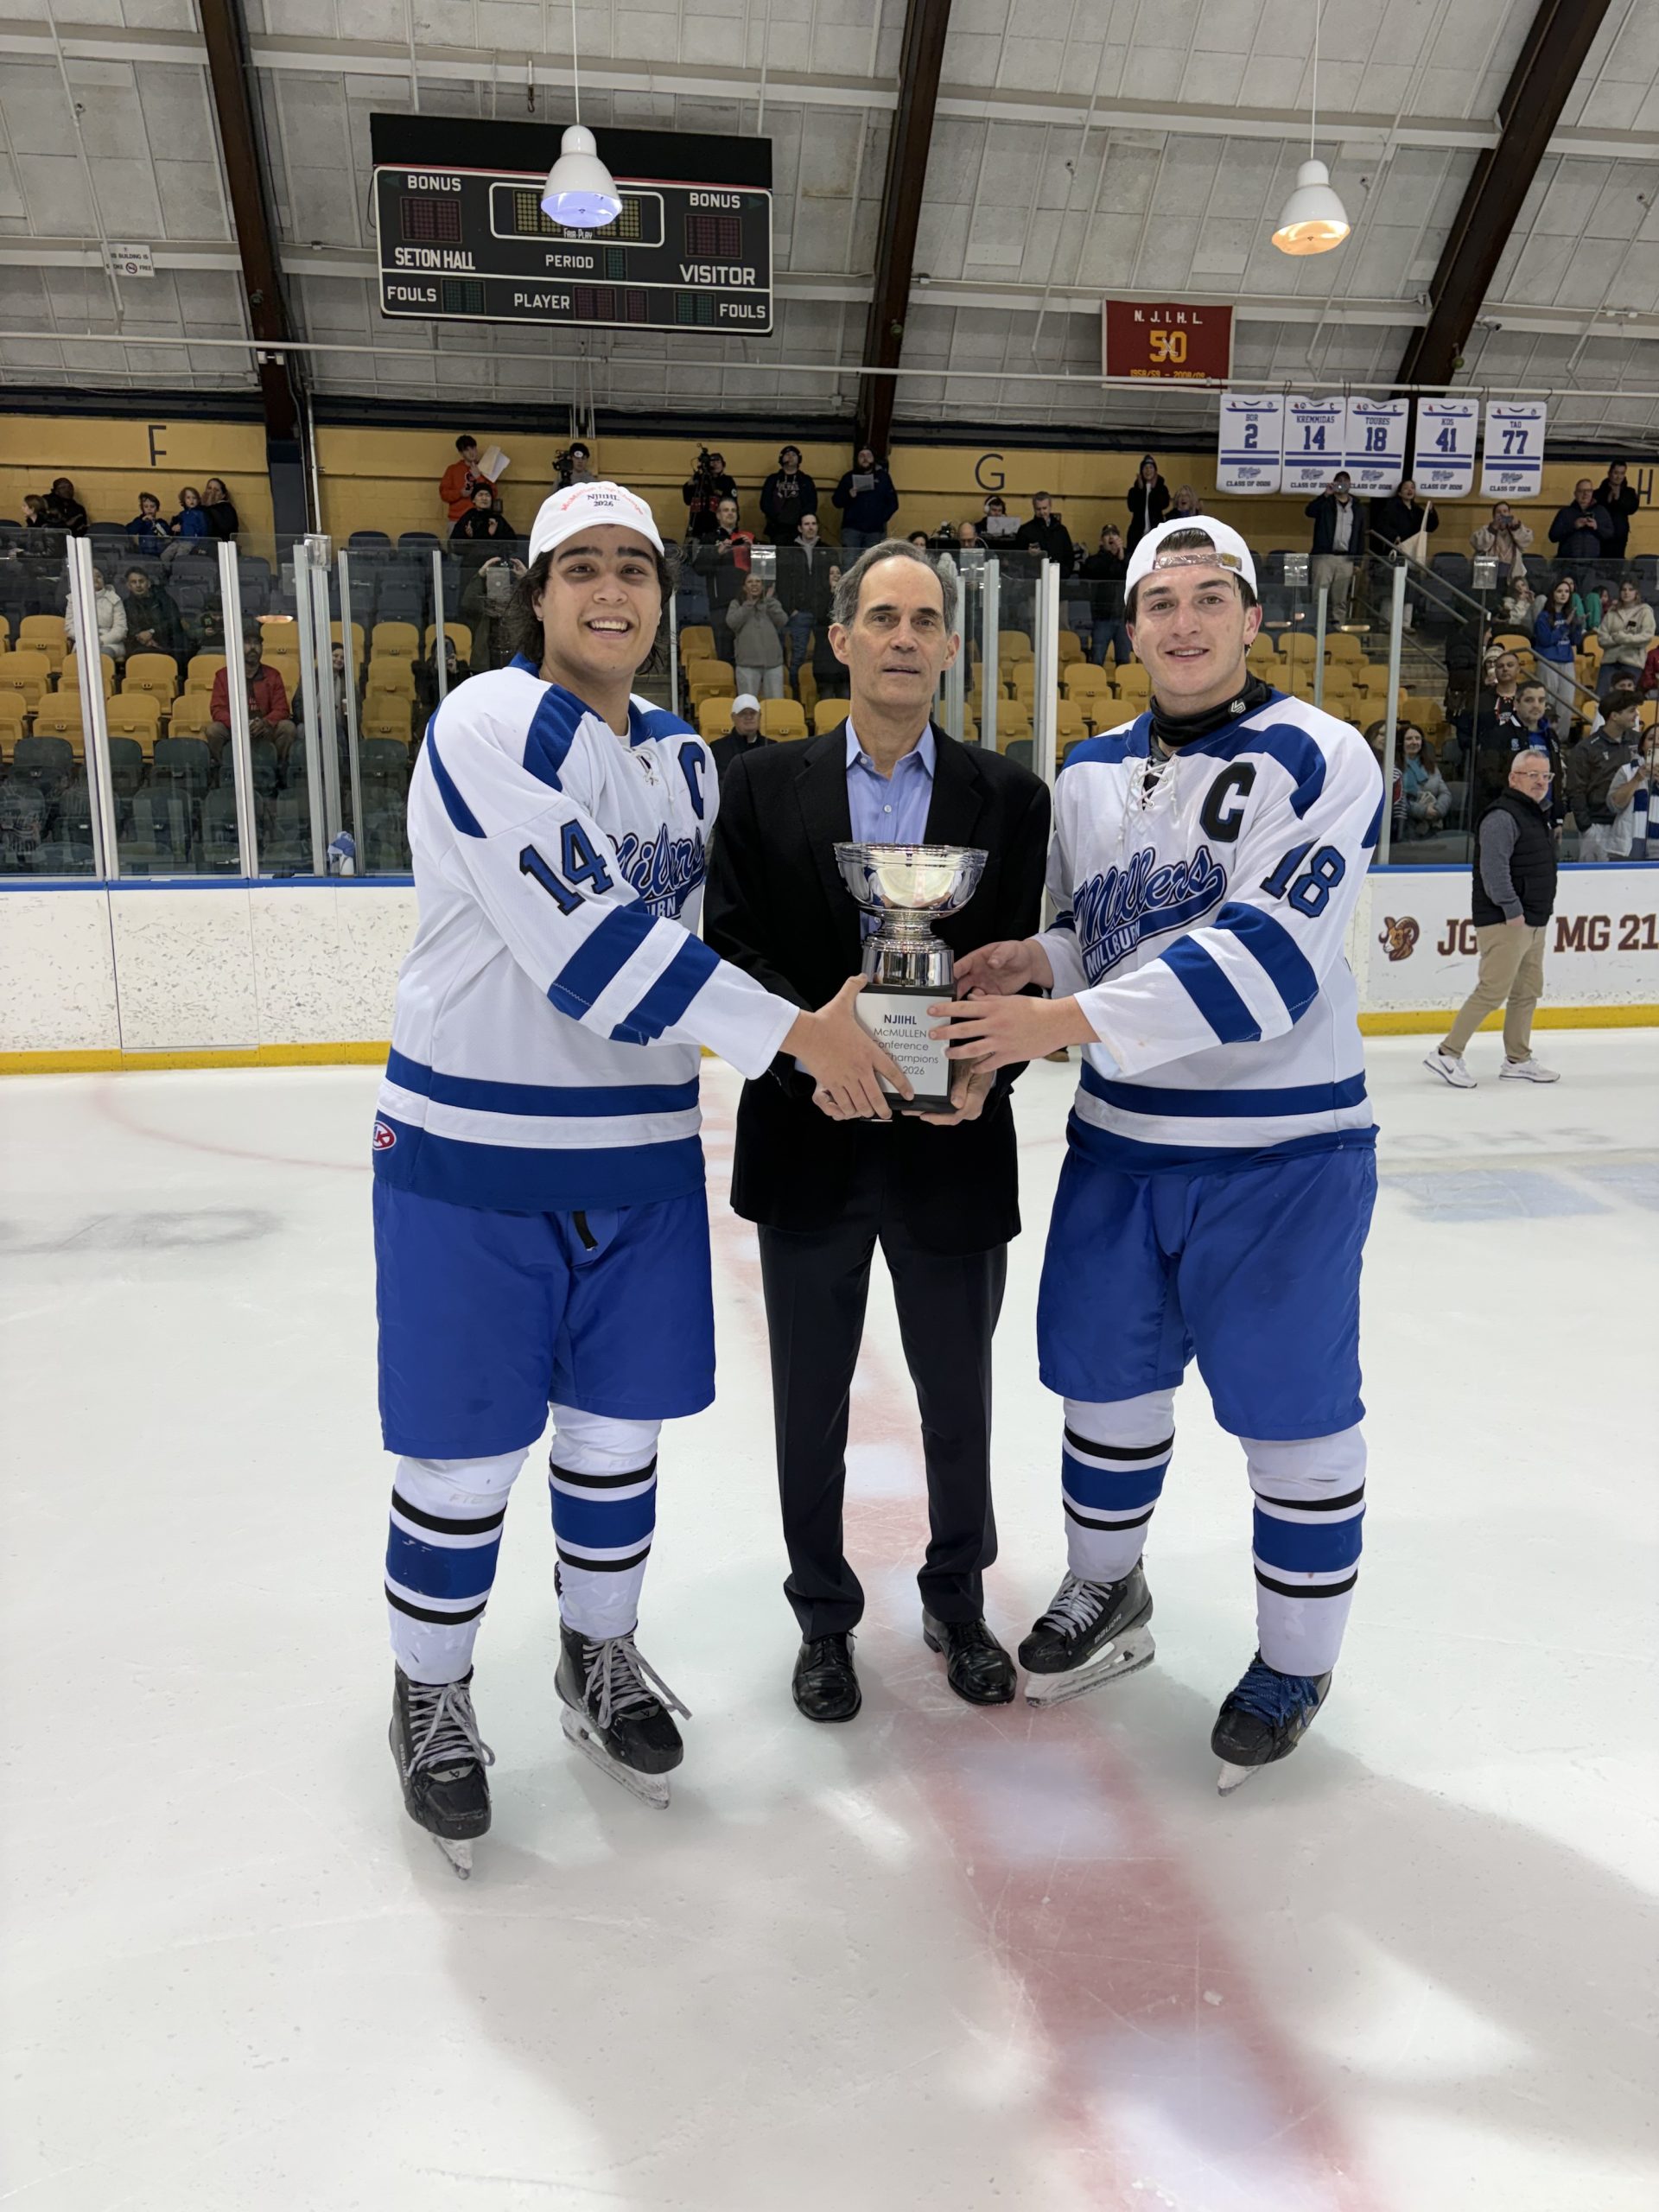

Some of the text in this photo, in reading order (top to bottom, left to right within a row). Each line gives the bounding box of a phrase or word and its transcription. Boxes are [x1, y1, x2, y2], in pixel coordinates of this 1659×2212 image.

[408, 175, 461, 192] BONUS
[690, 193, 741, 208] BONUS
[395, 247, 475, 270] SETON HALL
[545, 254, 594, 269] PERIOD
[679, 264, 755, 285] VISITOR
[387, 286, 436, 302] FOULS
[514, 293, 569, 309] PLAYER
[720, 303, 766, 319] FOULS
[1149, 330, 1187, 363] 50
[148, 425, 167, 466] F
[1244, 423, 1258, 448] 2
[1304, 425, 1325, 450] 14
[1365, 427, 1387, 451] 18
[1435, 428, 1457, 452] 41
[1502, 430, 1529, 454] 77
[975, 454, 1005, 491] G
[1637, 468, 1654, 505] H
[1199, 762, 1256, 842] C
[519, 818, 614, 916] 14
[1260, 837, 1346, 918] 18
[1073, 844, 1227, 948] Millers
[1554, 916, 1611, 952] MG
[1618, 913, 1659, 950] 21
[884, 1014, 917, 1025] NJIIHL
[874, 1027, 926, 1038] McMULLEN
[873, 1039, 929, 1051] onference
[885, 1052, 938, 1064] hampions
[903, 1065, 925, 1075] 2026
